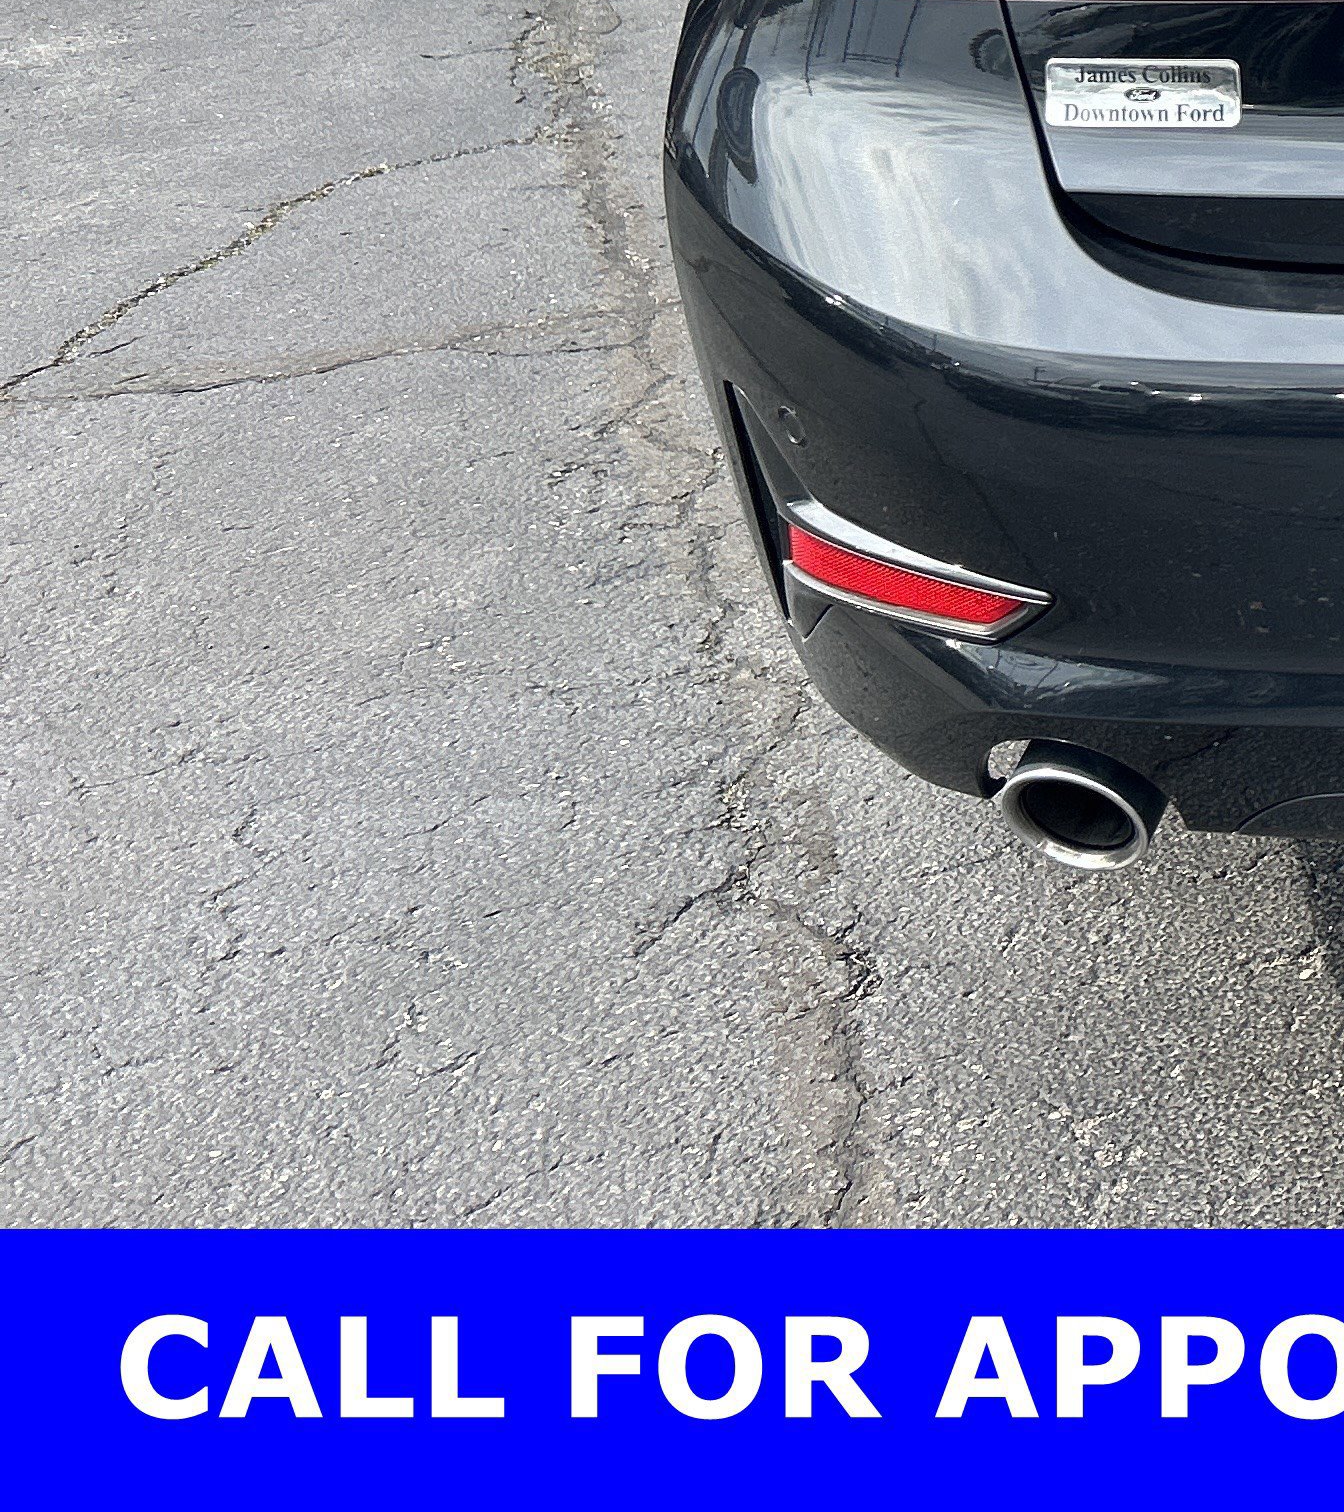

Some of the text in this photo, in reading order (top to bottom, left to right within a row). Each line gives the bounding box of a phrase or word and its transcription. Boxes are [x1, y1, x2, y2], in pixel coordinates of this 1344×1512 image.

[1075, 64, 1212, 84] James Collins
[1064, 103, 1226, 122] Downtown Ford
